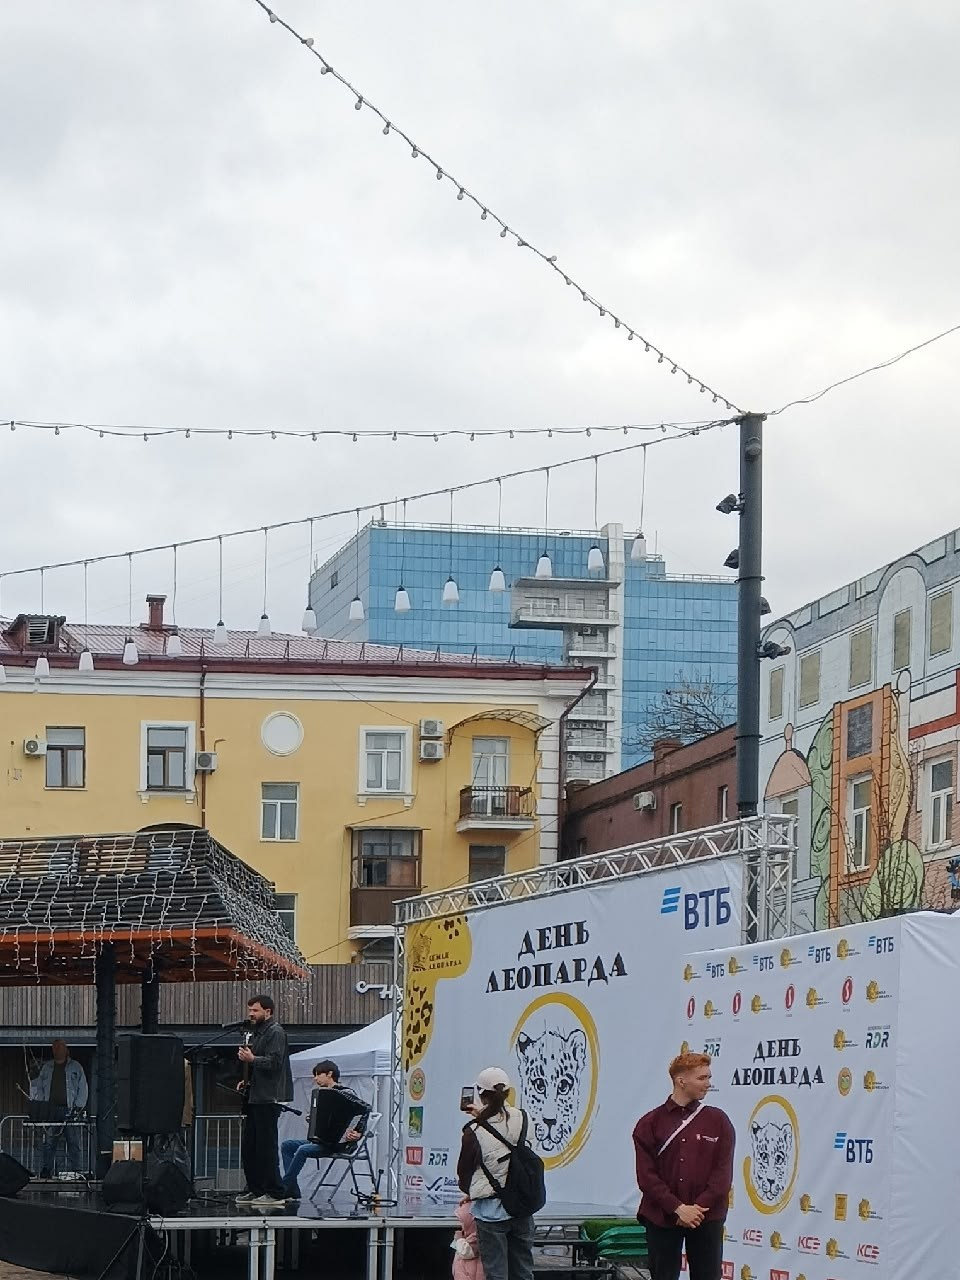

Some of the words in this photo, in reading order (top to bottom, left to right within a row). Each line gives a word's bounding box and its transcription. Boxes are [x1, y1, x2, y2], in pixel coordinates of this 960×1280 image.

[684, 887, 731, 930] ВТБ
[518, 920, 590, 961] ДЕНЬ
[876, 937, 894, 954] ВТБ
[760, 956, 774, 971] ВТБ
[815, 947, 831, 963] ВТБ
[485, 952, 628, 993] ЛЕОПАРДА
[712, 963, 725, 978] ВТБ
[753, 1038, 802, 1063] ДЕНЬ
[866, 1031, 890, 1049] RDR
[731, 1065, 825, 1089] ЛЕОПАРДА
[846, 1139, 874, 1163] ВТБ
